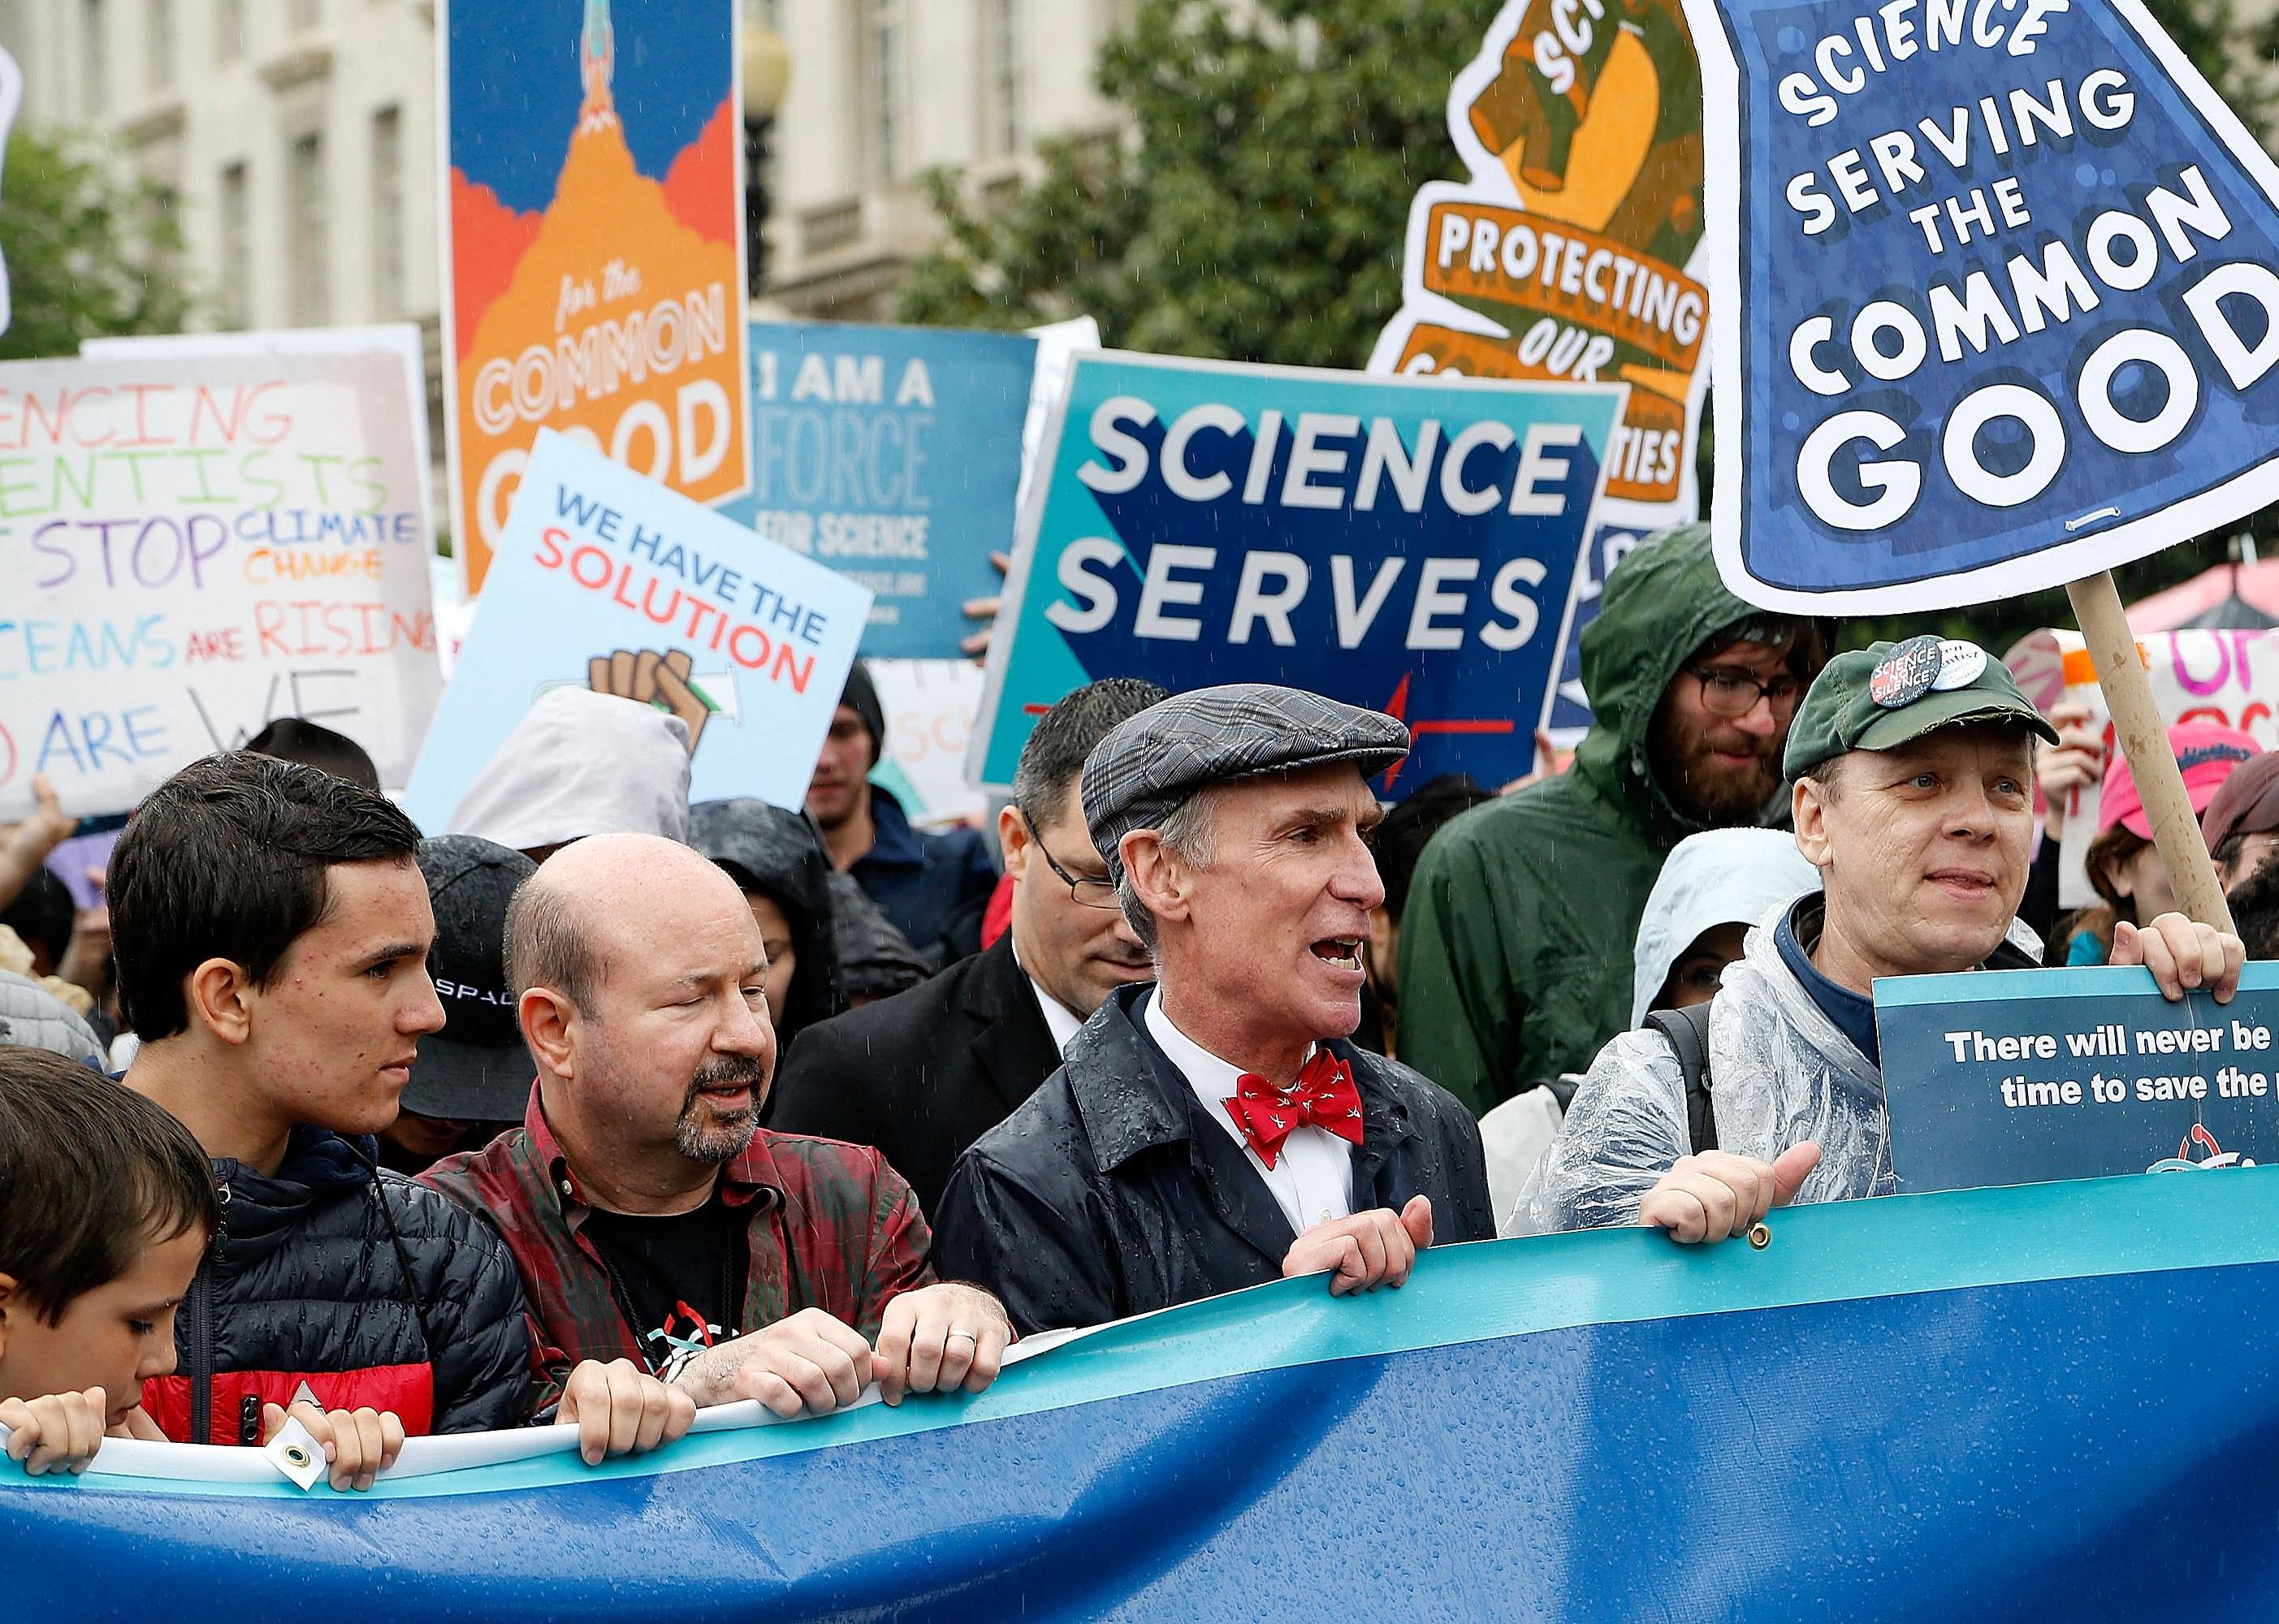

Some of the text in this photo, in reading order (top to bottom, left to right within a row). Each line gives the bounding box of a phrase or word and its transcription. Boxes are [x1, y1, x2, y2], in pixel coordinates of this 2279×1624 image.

[1777, 0, 2069, 127] SCIENCE
[1785, 69, 2136, 235] SERVING
[1909, 176, 2031, 255] THE
[555, 257, 642, 333] for the
[1437, 213, 1704, 347] PROTECTING
[1788, 164, 2233, 397] COMMON
[473, 282, 726, 436] COMMON
[757, 349, 936, 408] I AM A
[1517, 317, 1615, 383] OUR
[1795, 261, 2279, 532] GOOD
[0, 449, 391, 519] ENTISTS
[476, 378, 731, 555] GOD
[756, 407, 935, 508] FORCE
[1075, 395, 1585, 517] SCIENCE
[31, 513, 229, 590] STOP
[234, 508, 420, 545] CLIMATE
[756, 510, 928, 559] FOR SCIENCE
[243, 549, 385, 585] CHANGE
[556, 485, 622, 544] WE
[629, 524, 742, 603] HAVE
[751, 581, 828, 647] THE
[1044, 537, 1548, 651] SERVES
[184, 627, 249, 664] ARE
[253, 598, 436, 659] RISING
[533, 525, 818, 694] SOLUTION
[1874, 646, 1937, 679] SCIENCE
[1874, 669, 1931, 700] SILENCE
[1888, 665, 1918, 683] NOT
[35, 703, 173, 775] ARE
[1944, 1020, 2271, 1064] There will never be
[2000, 1073, 2083, 1108] time
[2090, 1071, 2127, 1104] to
[2134, 1073, 2208, 1102] save
[2216, 1066, 2268, 1099] the
